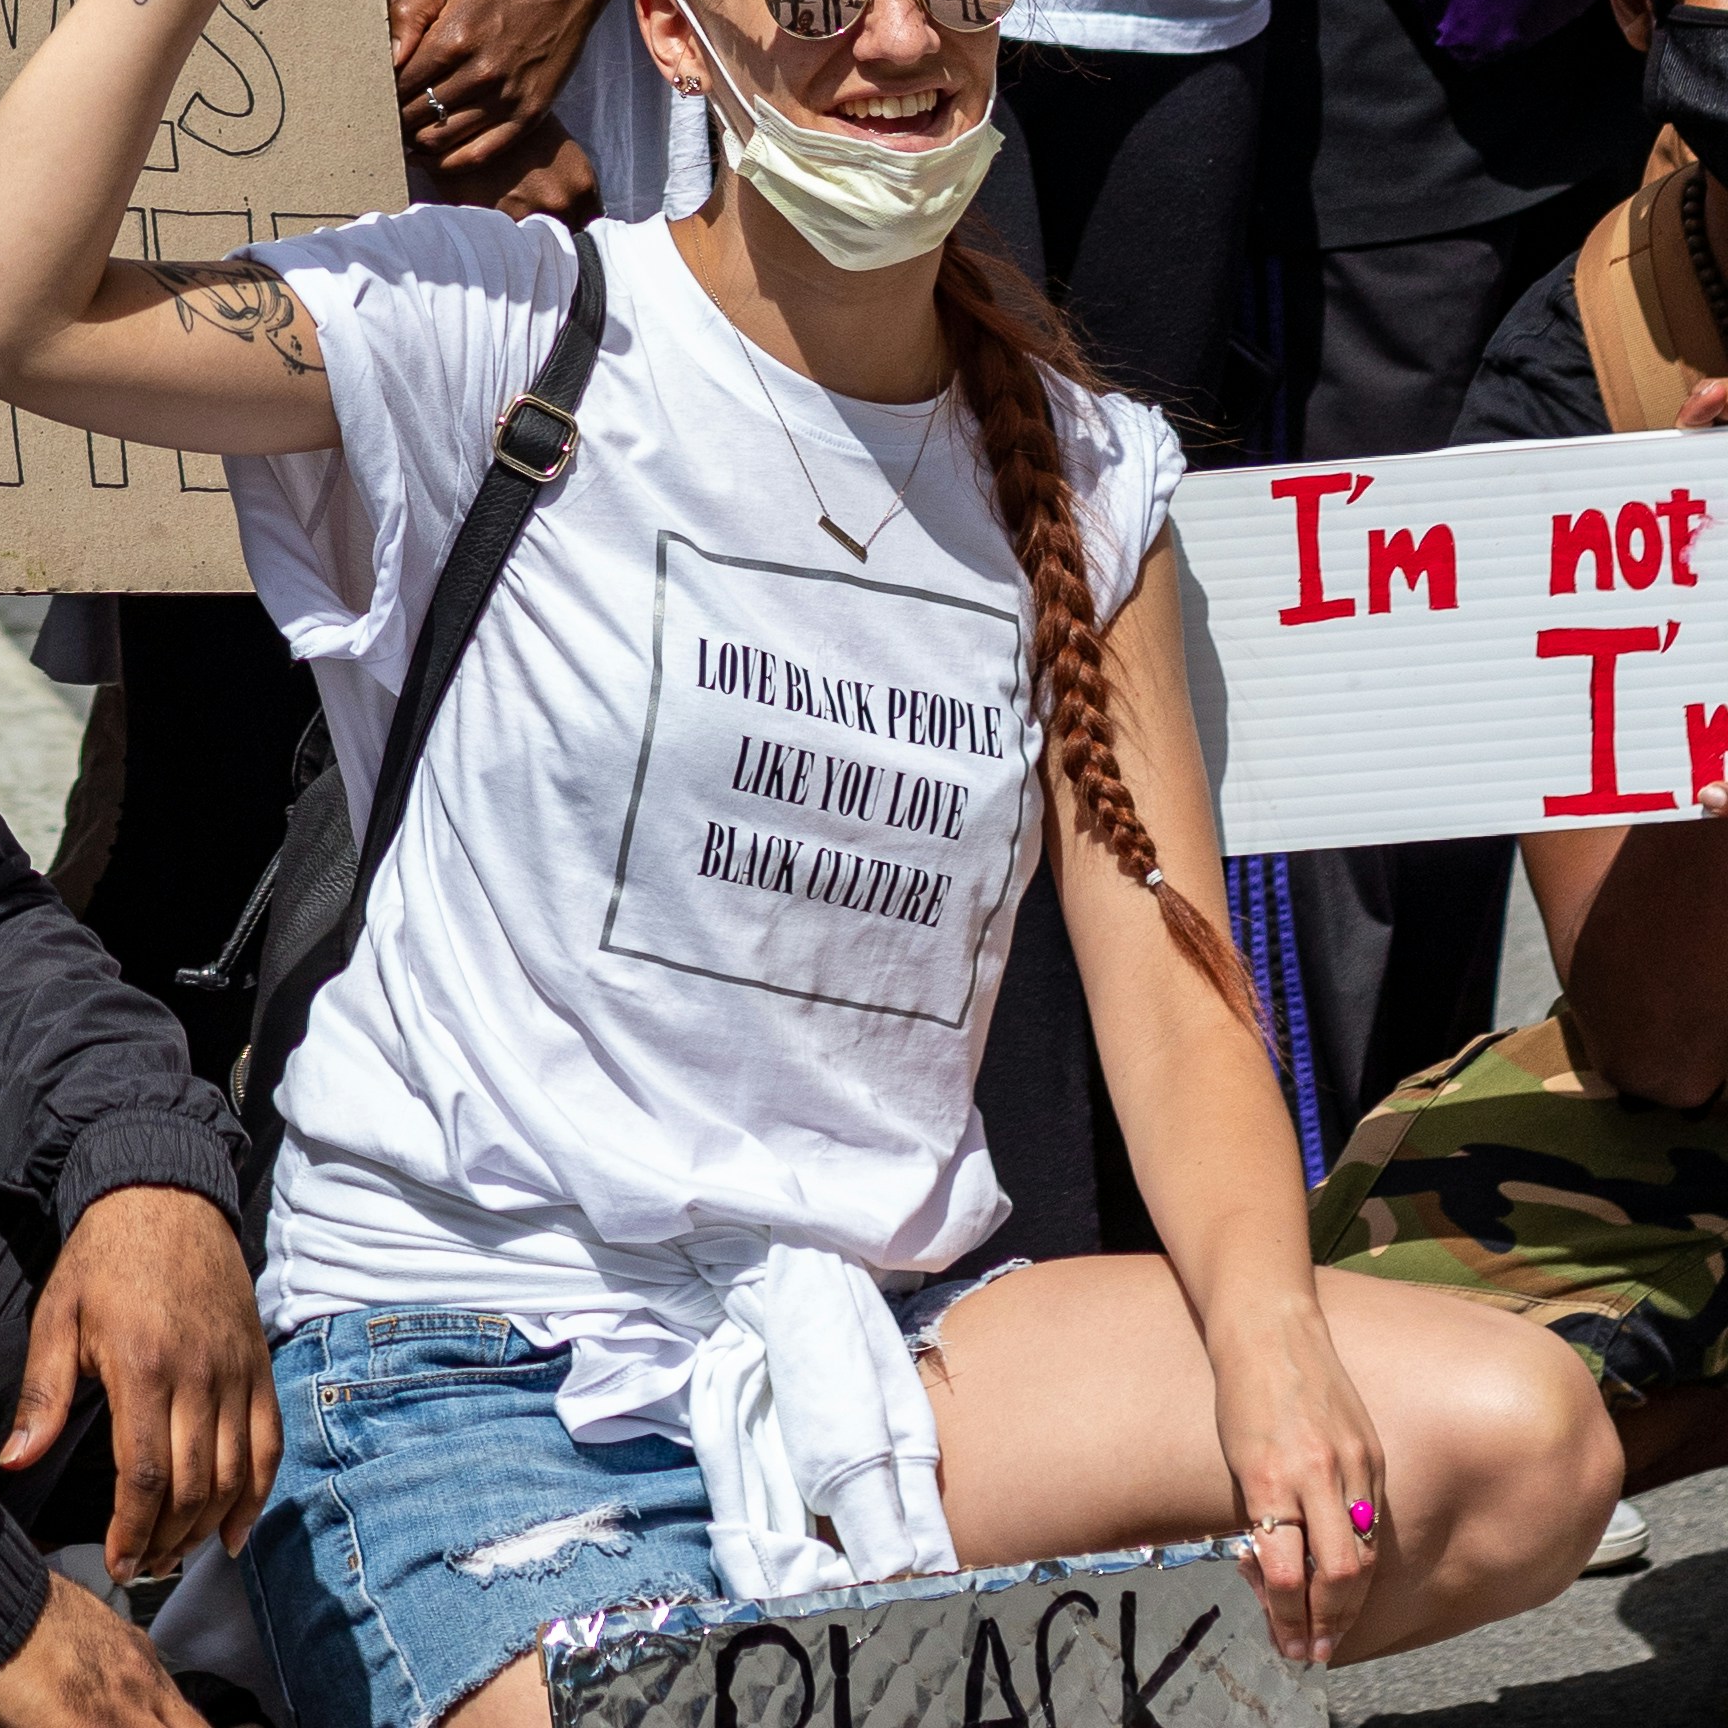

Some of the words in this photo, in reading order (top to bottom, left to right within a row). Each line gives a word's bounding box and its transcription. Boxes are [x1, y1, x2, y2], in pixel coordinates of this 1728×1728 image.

[1271, 472, 1459, 625] I'm
[1550, 488, 1706, 596] not
[696, 637, 777, 706] LOVE
[784, 659, 878, 735] BLACK
[888, 687, 1003, 759] PEOPLE
[731, 735, 815, 805] LIKE
[818, 755, 885, 821] YOU
[884, 771, 968, 840] LOVE
[697, 821, 804, 894] BLACK
[806, 847, 952, 927] CULTURE
